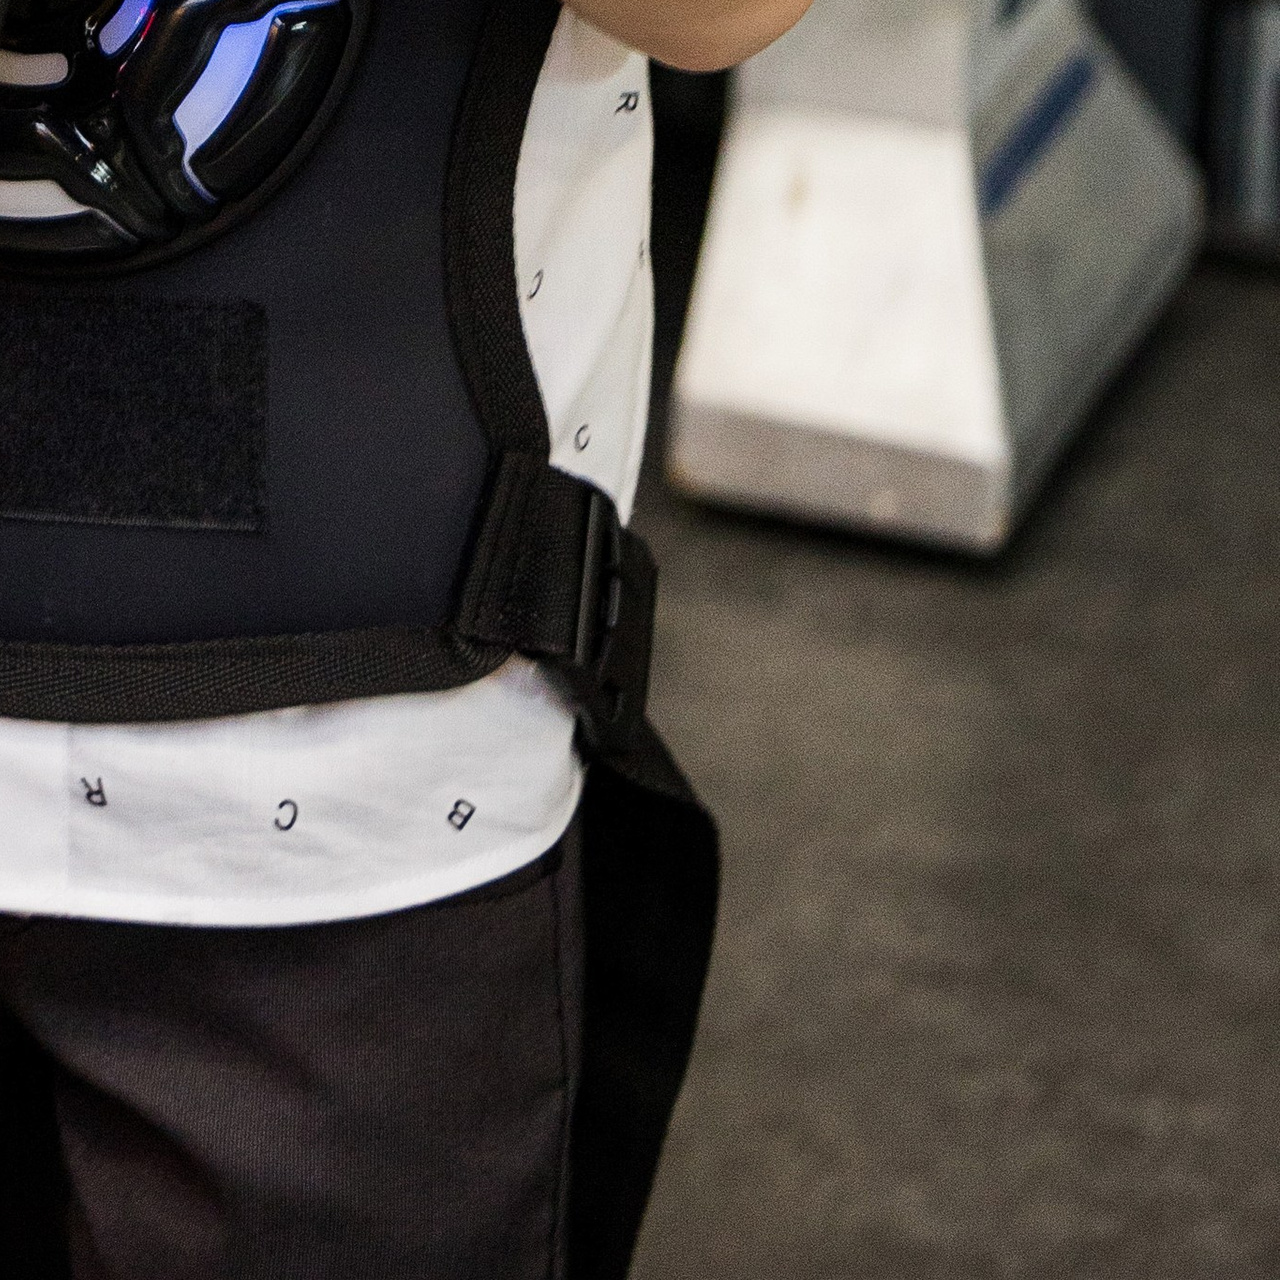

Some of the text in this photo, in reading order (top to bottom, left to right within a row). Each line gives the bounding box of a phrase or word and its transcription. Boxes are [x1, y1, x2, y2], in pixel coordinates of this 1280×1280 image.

[80, 776, 107, 807] R
[274, 799, 298, 831] C
[447, 798, 476, 831] B
